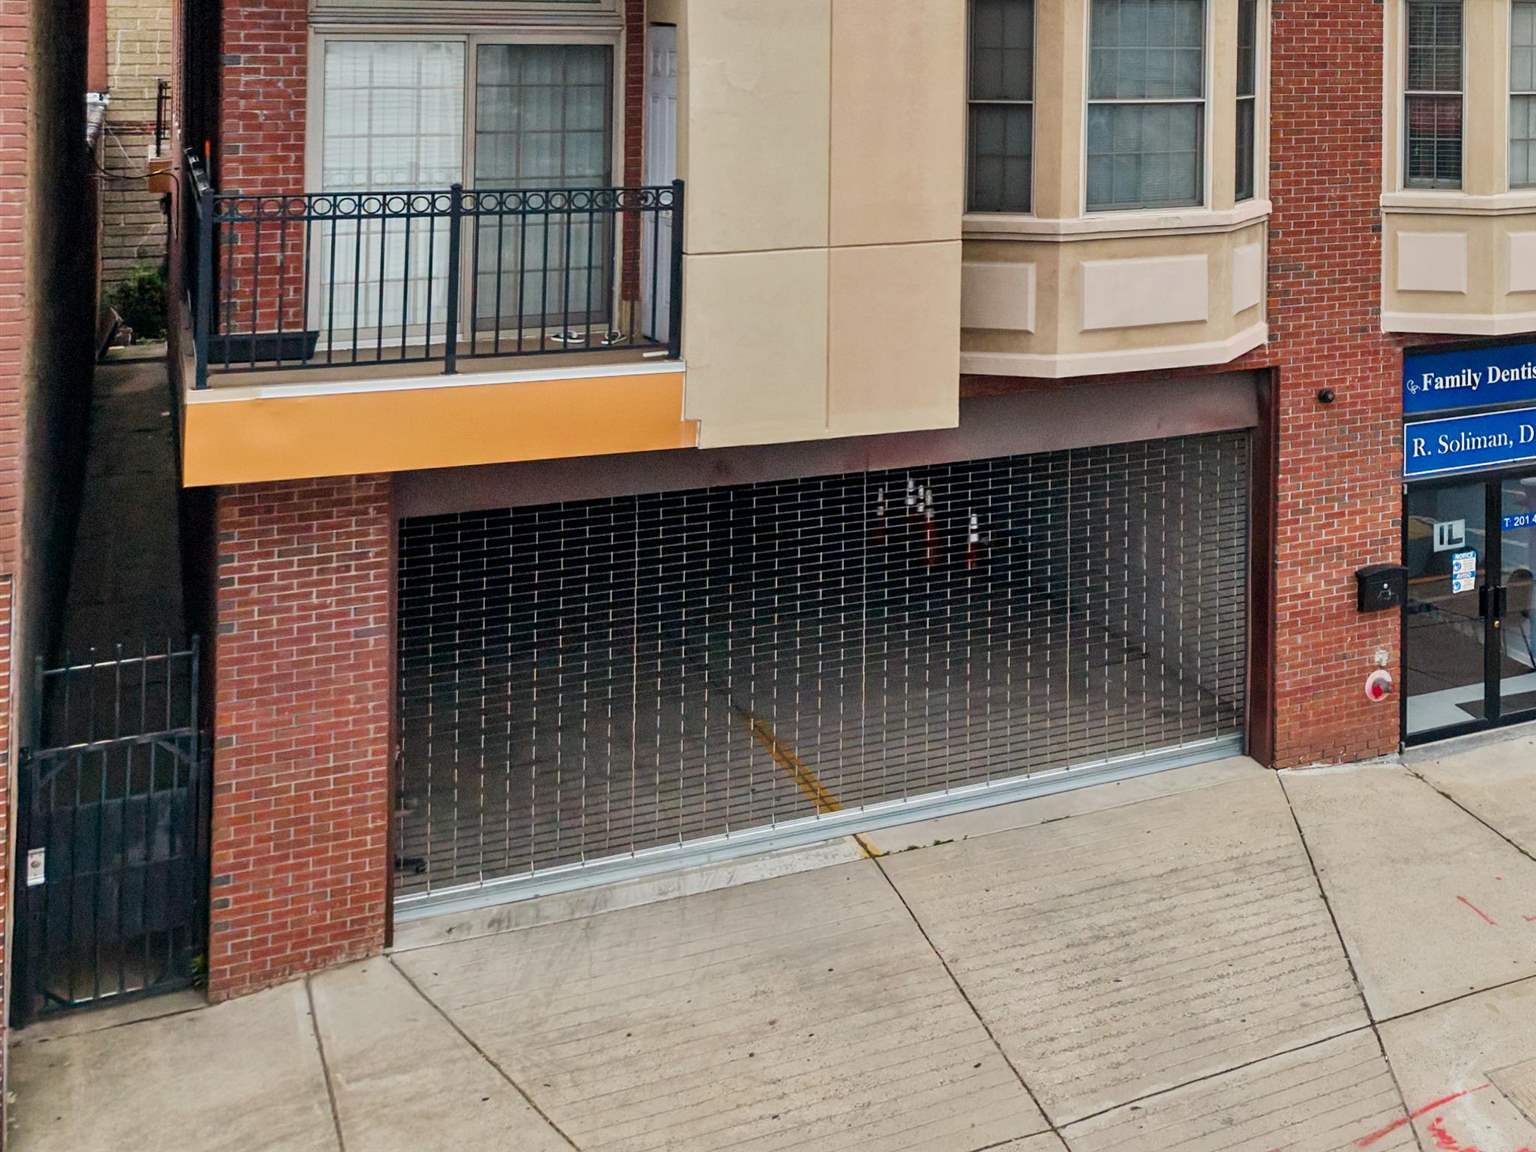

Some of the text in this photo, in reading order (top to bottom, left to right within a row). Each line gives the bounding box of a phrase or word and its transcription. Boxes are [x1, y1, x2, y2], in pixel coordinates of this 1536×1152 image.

[1421, 368, 1482, 391] Family
[1412, 437, 1432, 458] R.
[1437, 431, 1514, 455] Soliman,
[1513, 515, 1530, 527] 201
